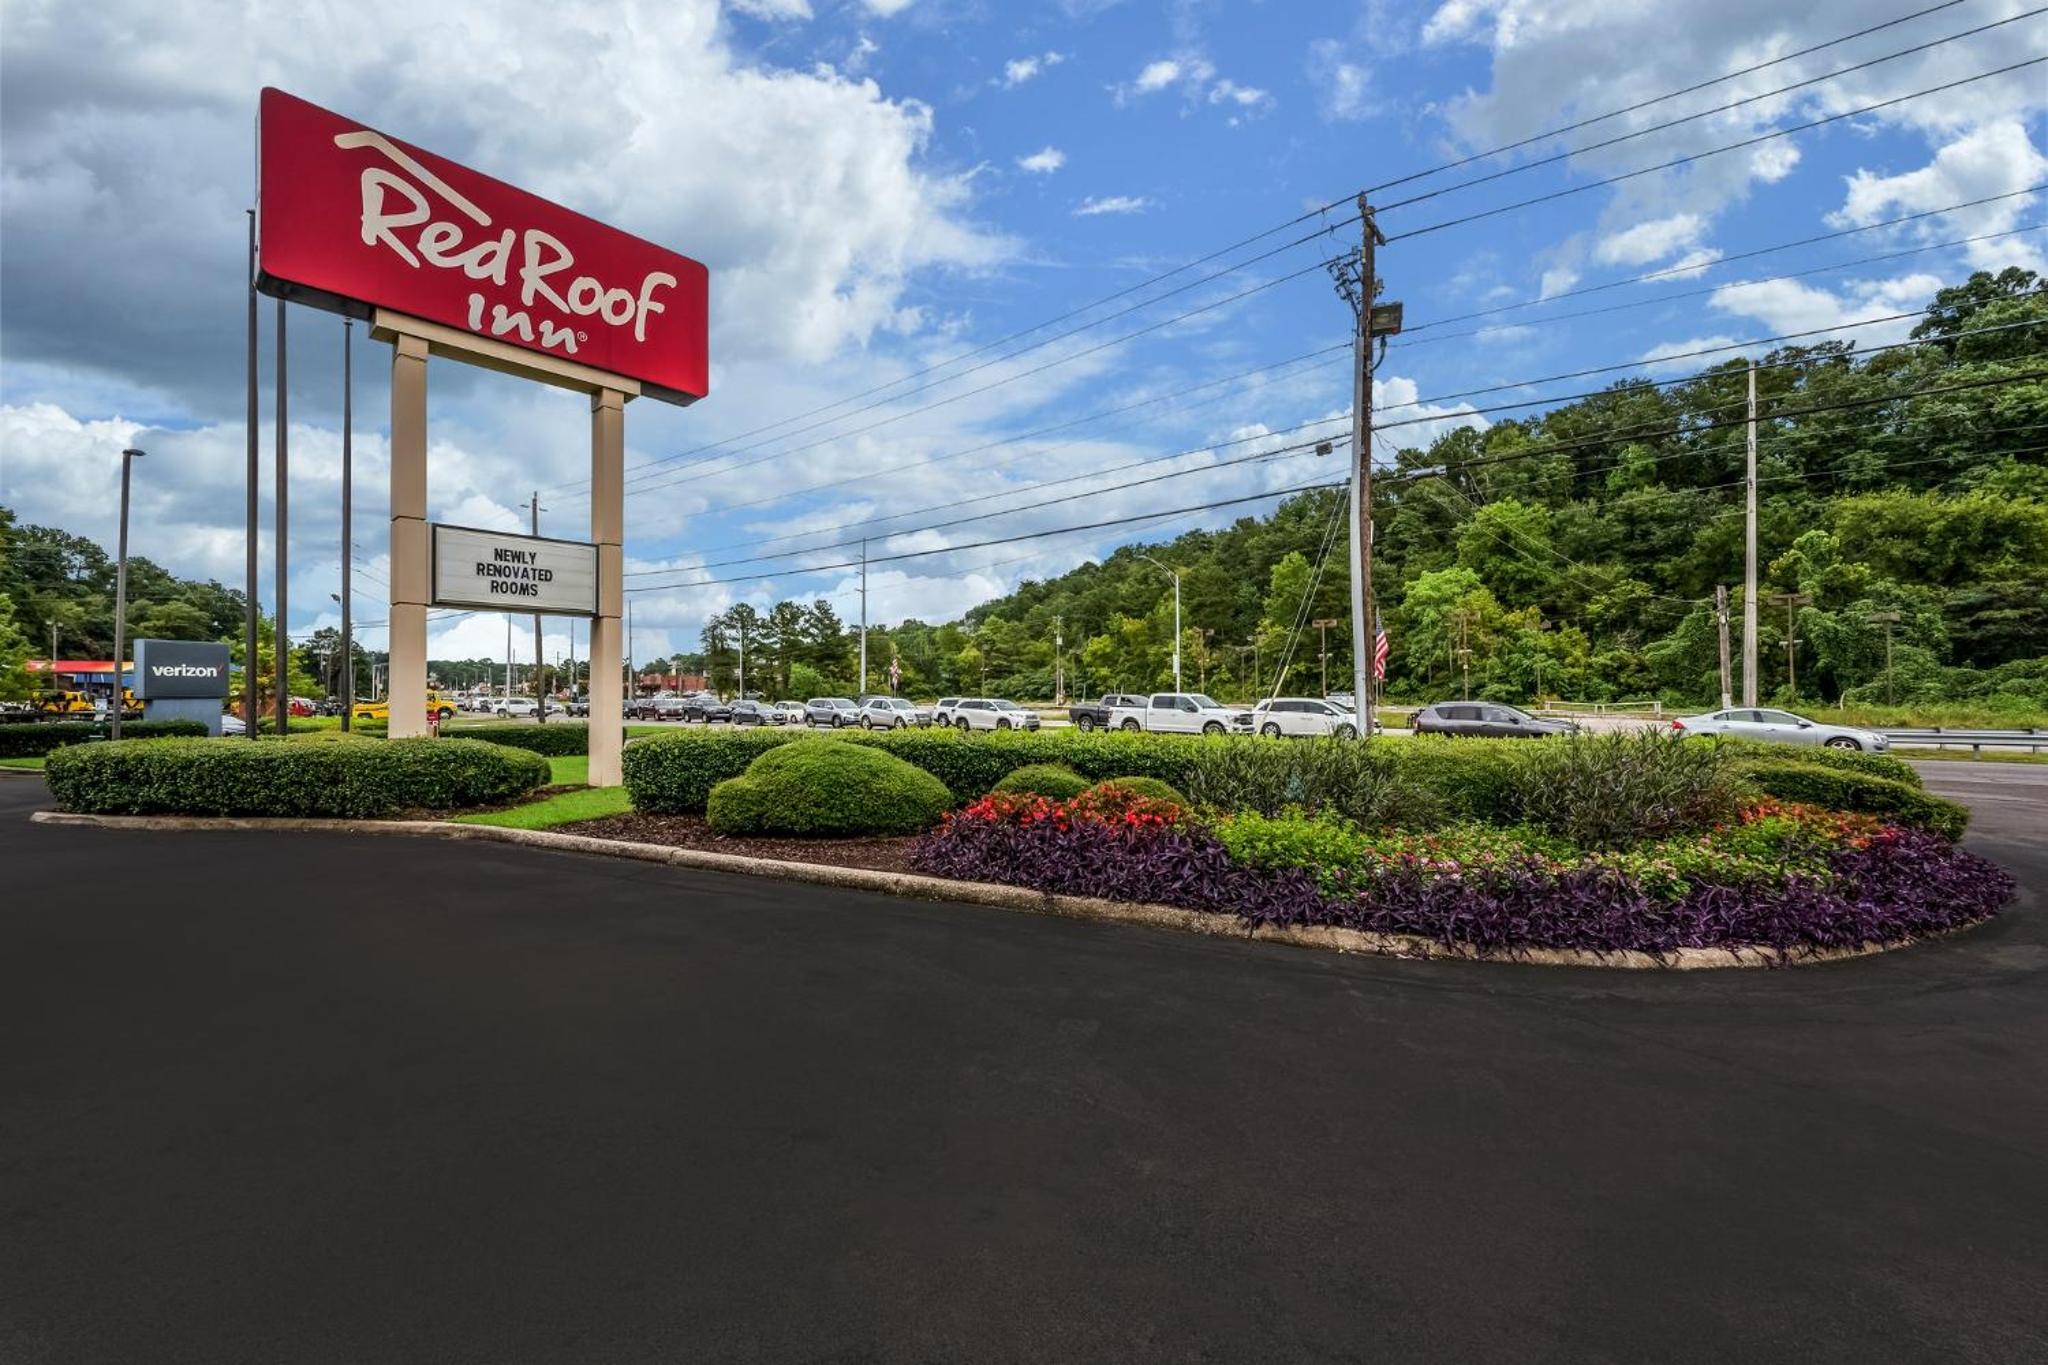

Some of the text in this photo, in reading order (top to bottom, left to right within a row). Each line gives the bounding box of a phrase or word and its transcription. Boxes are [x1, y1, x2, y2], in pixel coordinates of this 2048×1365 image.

[494, 548, 537, 565] NEWLY
[476, 562, 553, 582] RENOVATED
[490, 580, 538, 597] ROOMS
[152, 664, 218, 677] verizon
